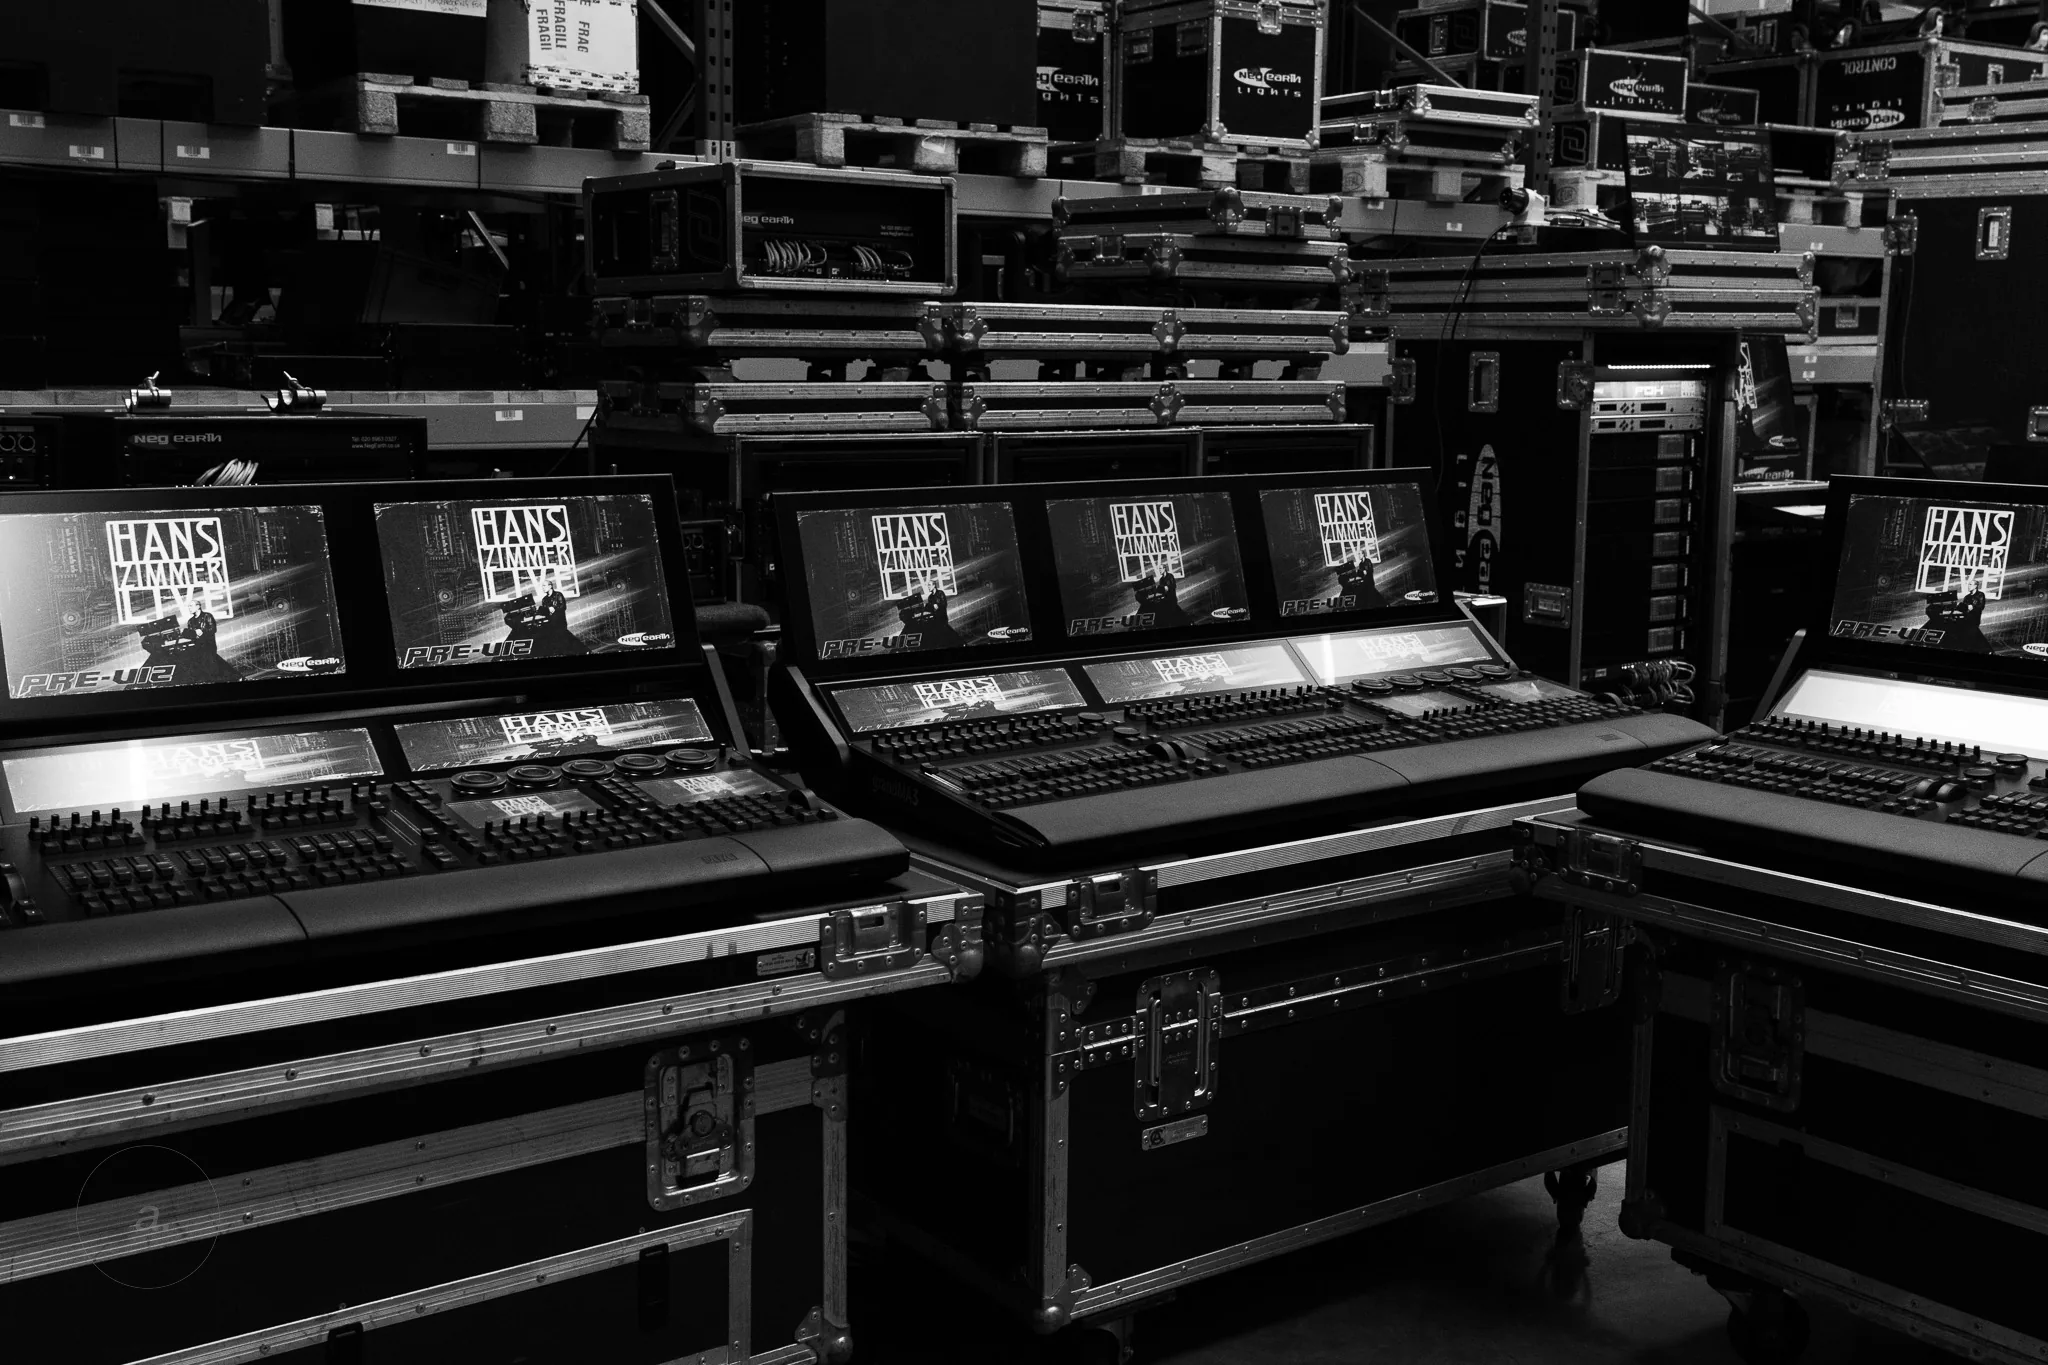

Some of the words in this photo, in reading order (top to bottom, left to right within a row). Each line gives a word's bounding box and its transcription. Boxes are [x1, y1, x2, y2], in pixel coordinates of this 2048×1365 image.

[1841, 56, 1897, 75] CONTROL
[1114, 503, 1174, 536] HANS
[1318, 493, 1371, 523] HANS
[478, 507, 567, 545] HANS
[876, 514, 946, 549] HANS
[1321, 521, 1374, 541] ZIMMER
[1928, 508, 2009, 546] HANS
[114, 519, 220, 561] HANS
[1117, 533, 1178, 555] ZIMMER
[481, 543, 572, 568] ZIMMER
[879, 546, 950, 570] ZIMMER
[1923, 543, 2005, 569] ZIMMER
[118, 560, 225, 588] ZIMMER
[918, 678, 996, 695] HANS
[505, 710, 603, 728] HANS
